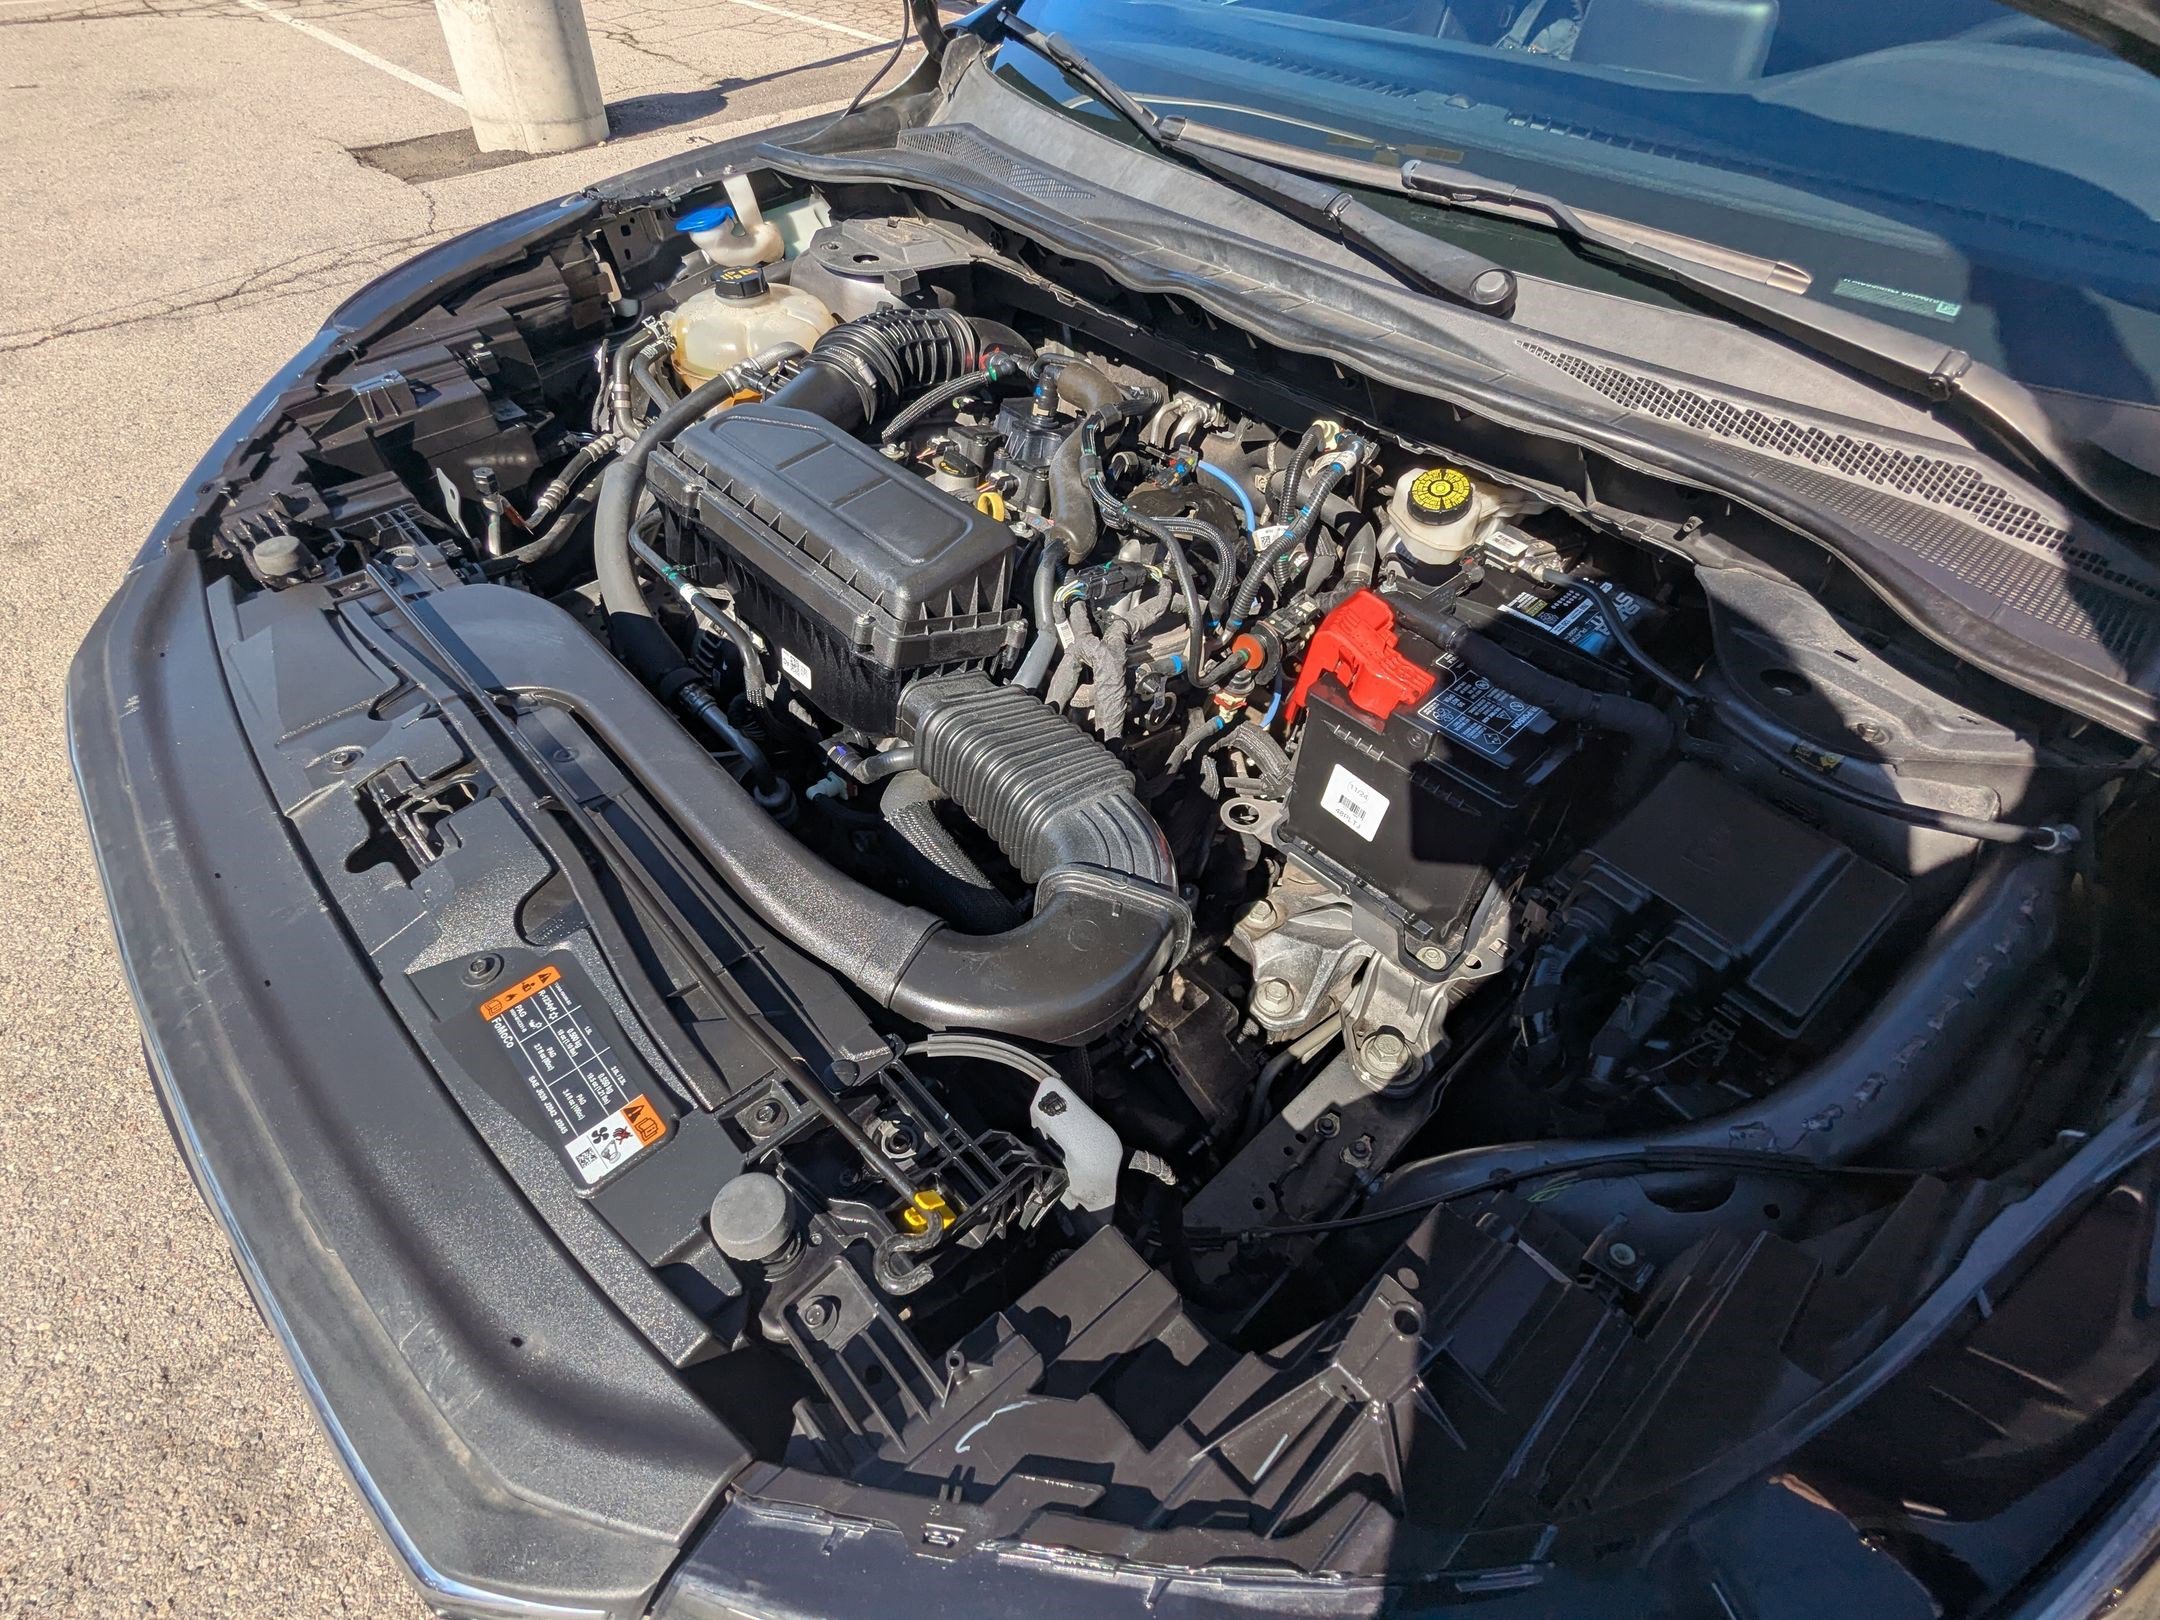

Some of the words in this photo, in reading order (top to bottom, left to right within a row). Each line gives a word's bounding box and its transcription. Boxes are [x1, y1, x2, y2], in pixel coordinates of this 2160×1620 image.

[1351, 784, 1368, 800] 11/24
[538, 990, 557, 1012] R-1234yf
[515, 1005, 527, 1017] PAG
[492, 1017, 514, 1048] FoMoCo
[575, 1040, 582, 1048] kg
[547, 1047, 556, 1058] PAG
[529, 1076, 539, 1088] SAE
[606, 1085, 614, 1094] kg
[576, 1094, 586, 1105] PAG
